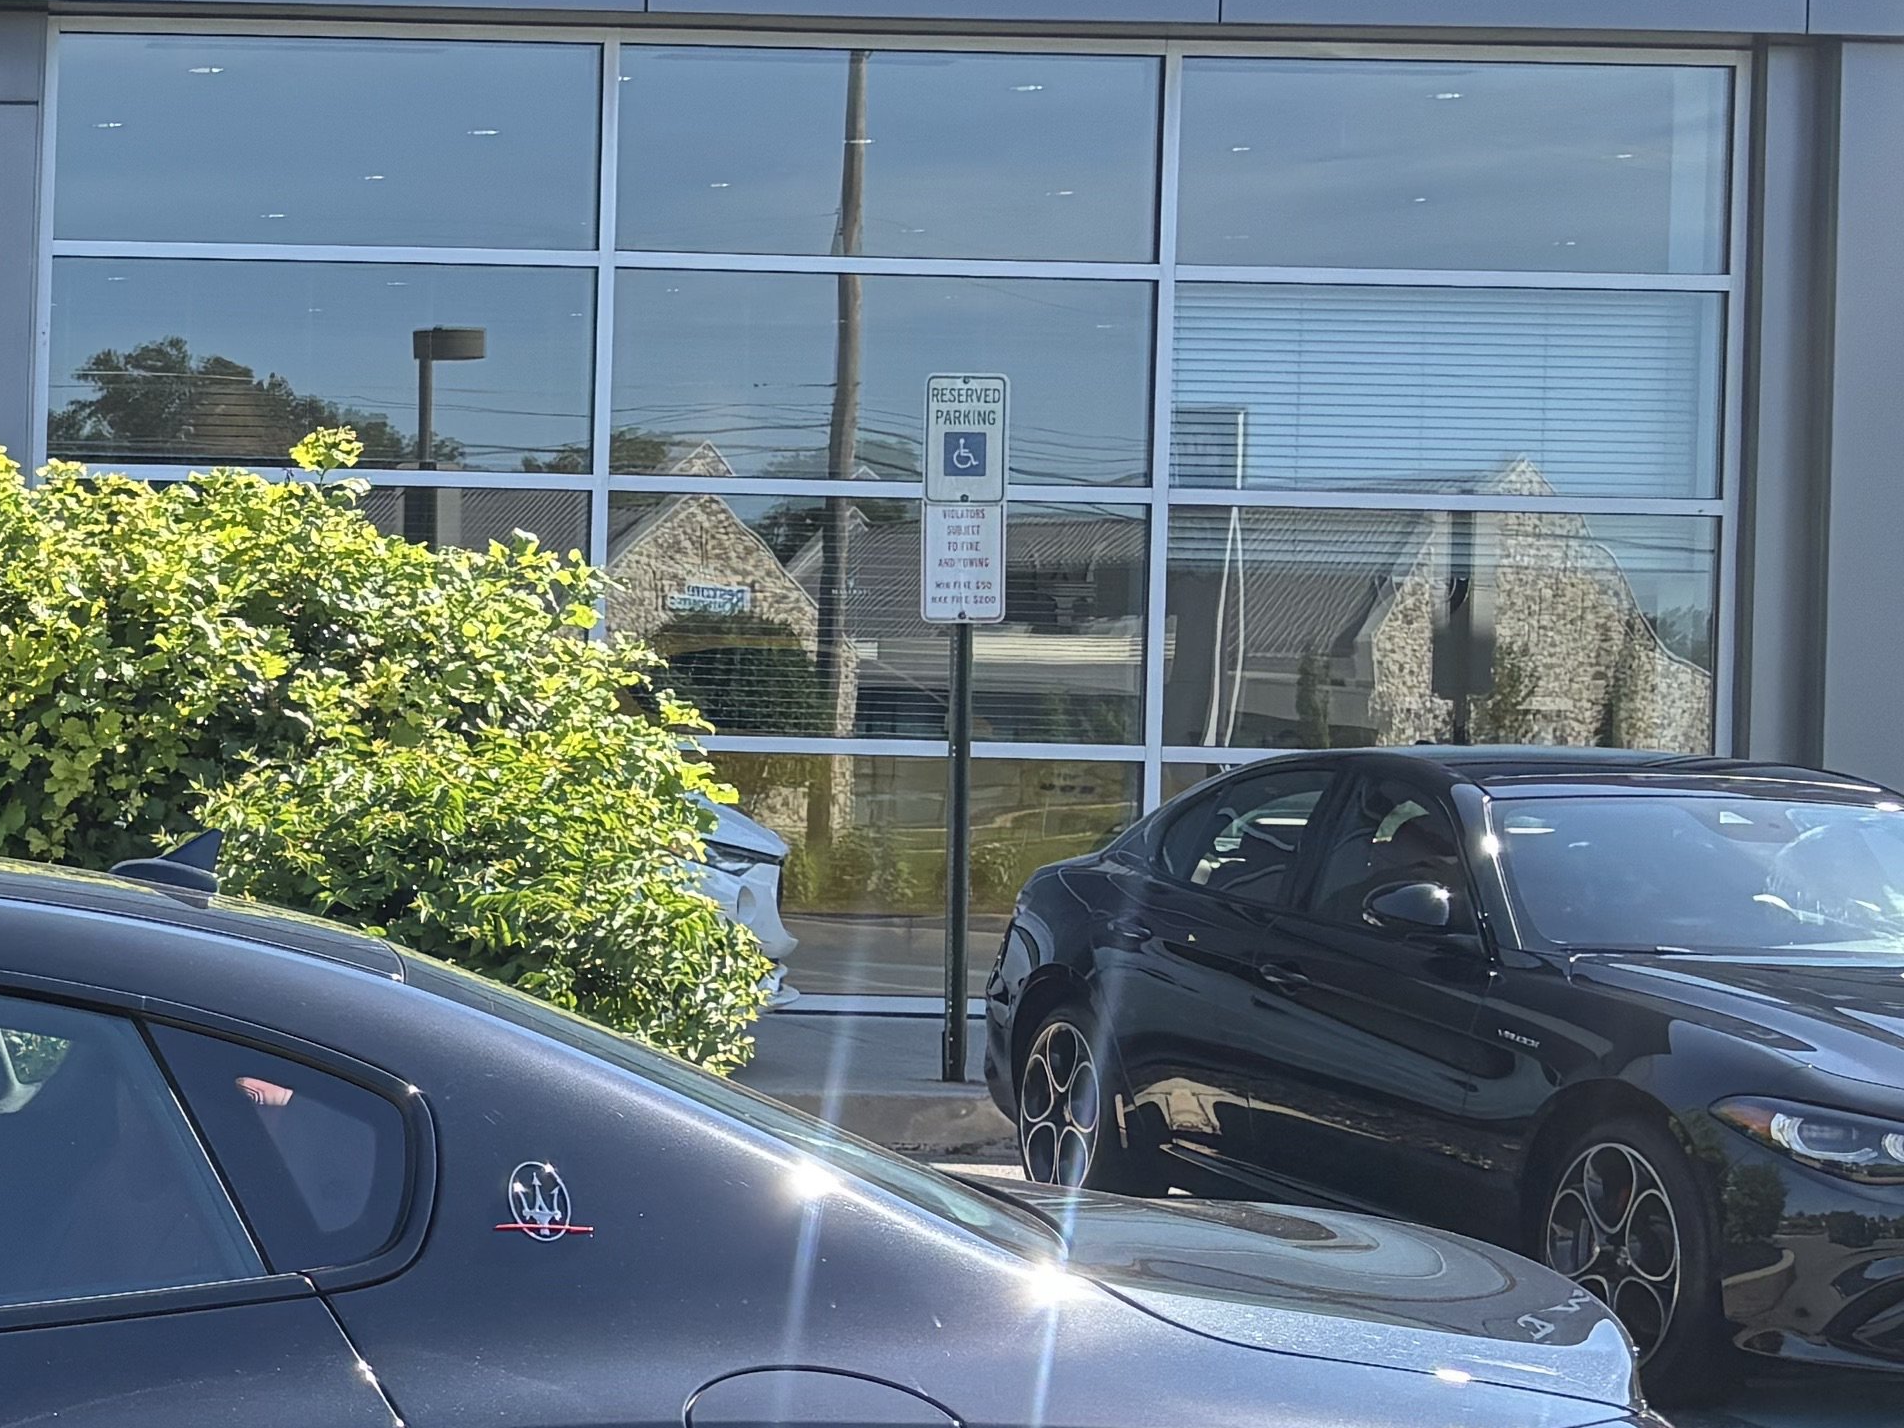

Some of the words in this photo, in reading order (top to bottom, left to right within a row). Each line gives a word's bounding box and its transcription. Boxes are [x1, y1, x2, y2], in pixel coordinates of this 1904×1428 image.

[931, 387, 1001, 403] RESERVED
[935, 409, 996, 425] PARKING
[942, 508, 986, 519] VIOLATORS
[946, 525, 981, 536] SUBJECT
[947, 541, 958, 551] TO
[961, 541, 981, 552] FINE
[938, 558, 955, 568] AND
[957, 557, 990, 568] TOWING
[973, 595, 997, 604] $200
